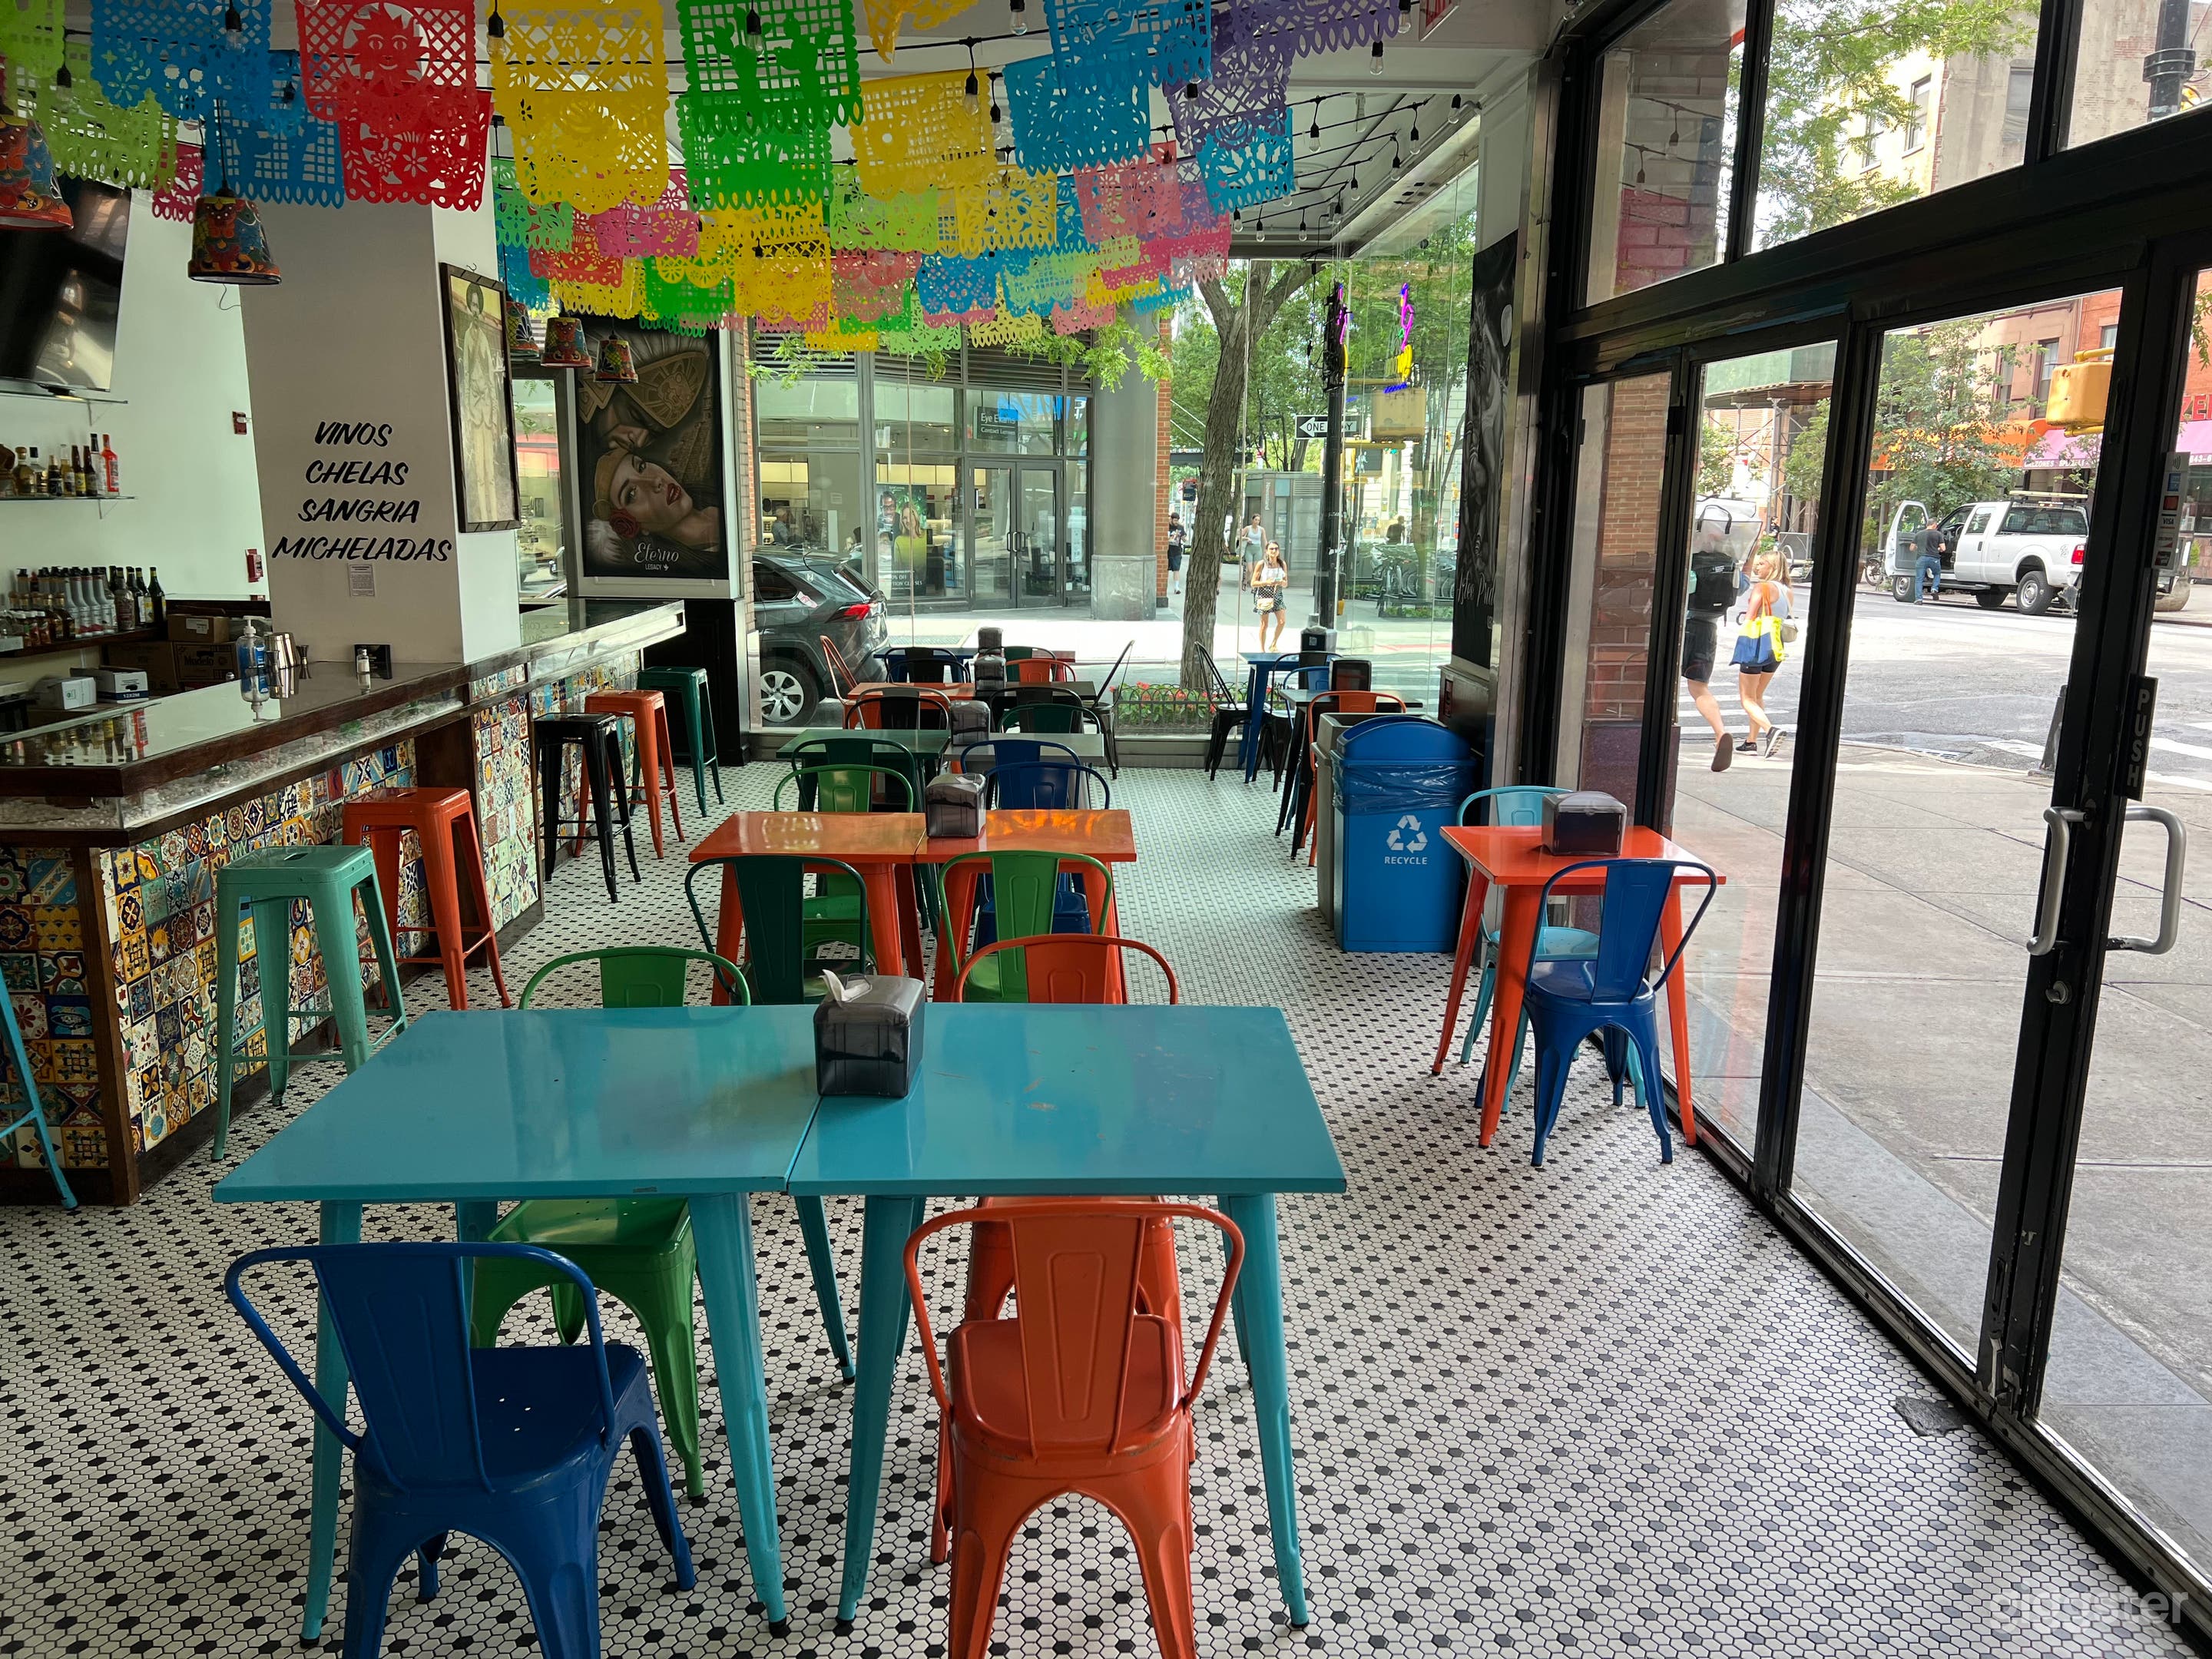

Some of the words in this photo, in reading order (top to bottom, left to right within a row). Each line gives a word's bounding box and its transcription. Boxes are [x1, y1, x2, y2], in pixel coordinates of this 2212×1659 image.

[981, 412, 992, 423] Eye
[1306, 422, 1325, 432] ONE
[314, 422, 392, 447] VINOS
[306, 460, 409, 485] CHELAS
[297, 498, 420, 523] SANGRIA
[272, 536, 452, 561] MICHELADAS
[634, 542, 679, 563] Eterno
[1476, 572, 1496, 607] Prid
[2127, 688, 2150, 787] PUSH
[1384, 856, 1428, 865] RECYCLE
